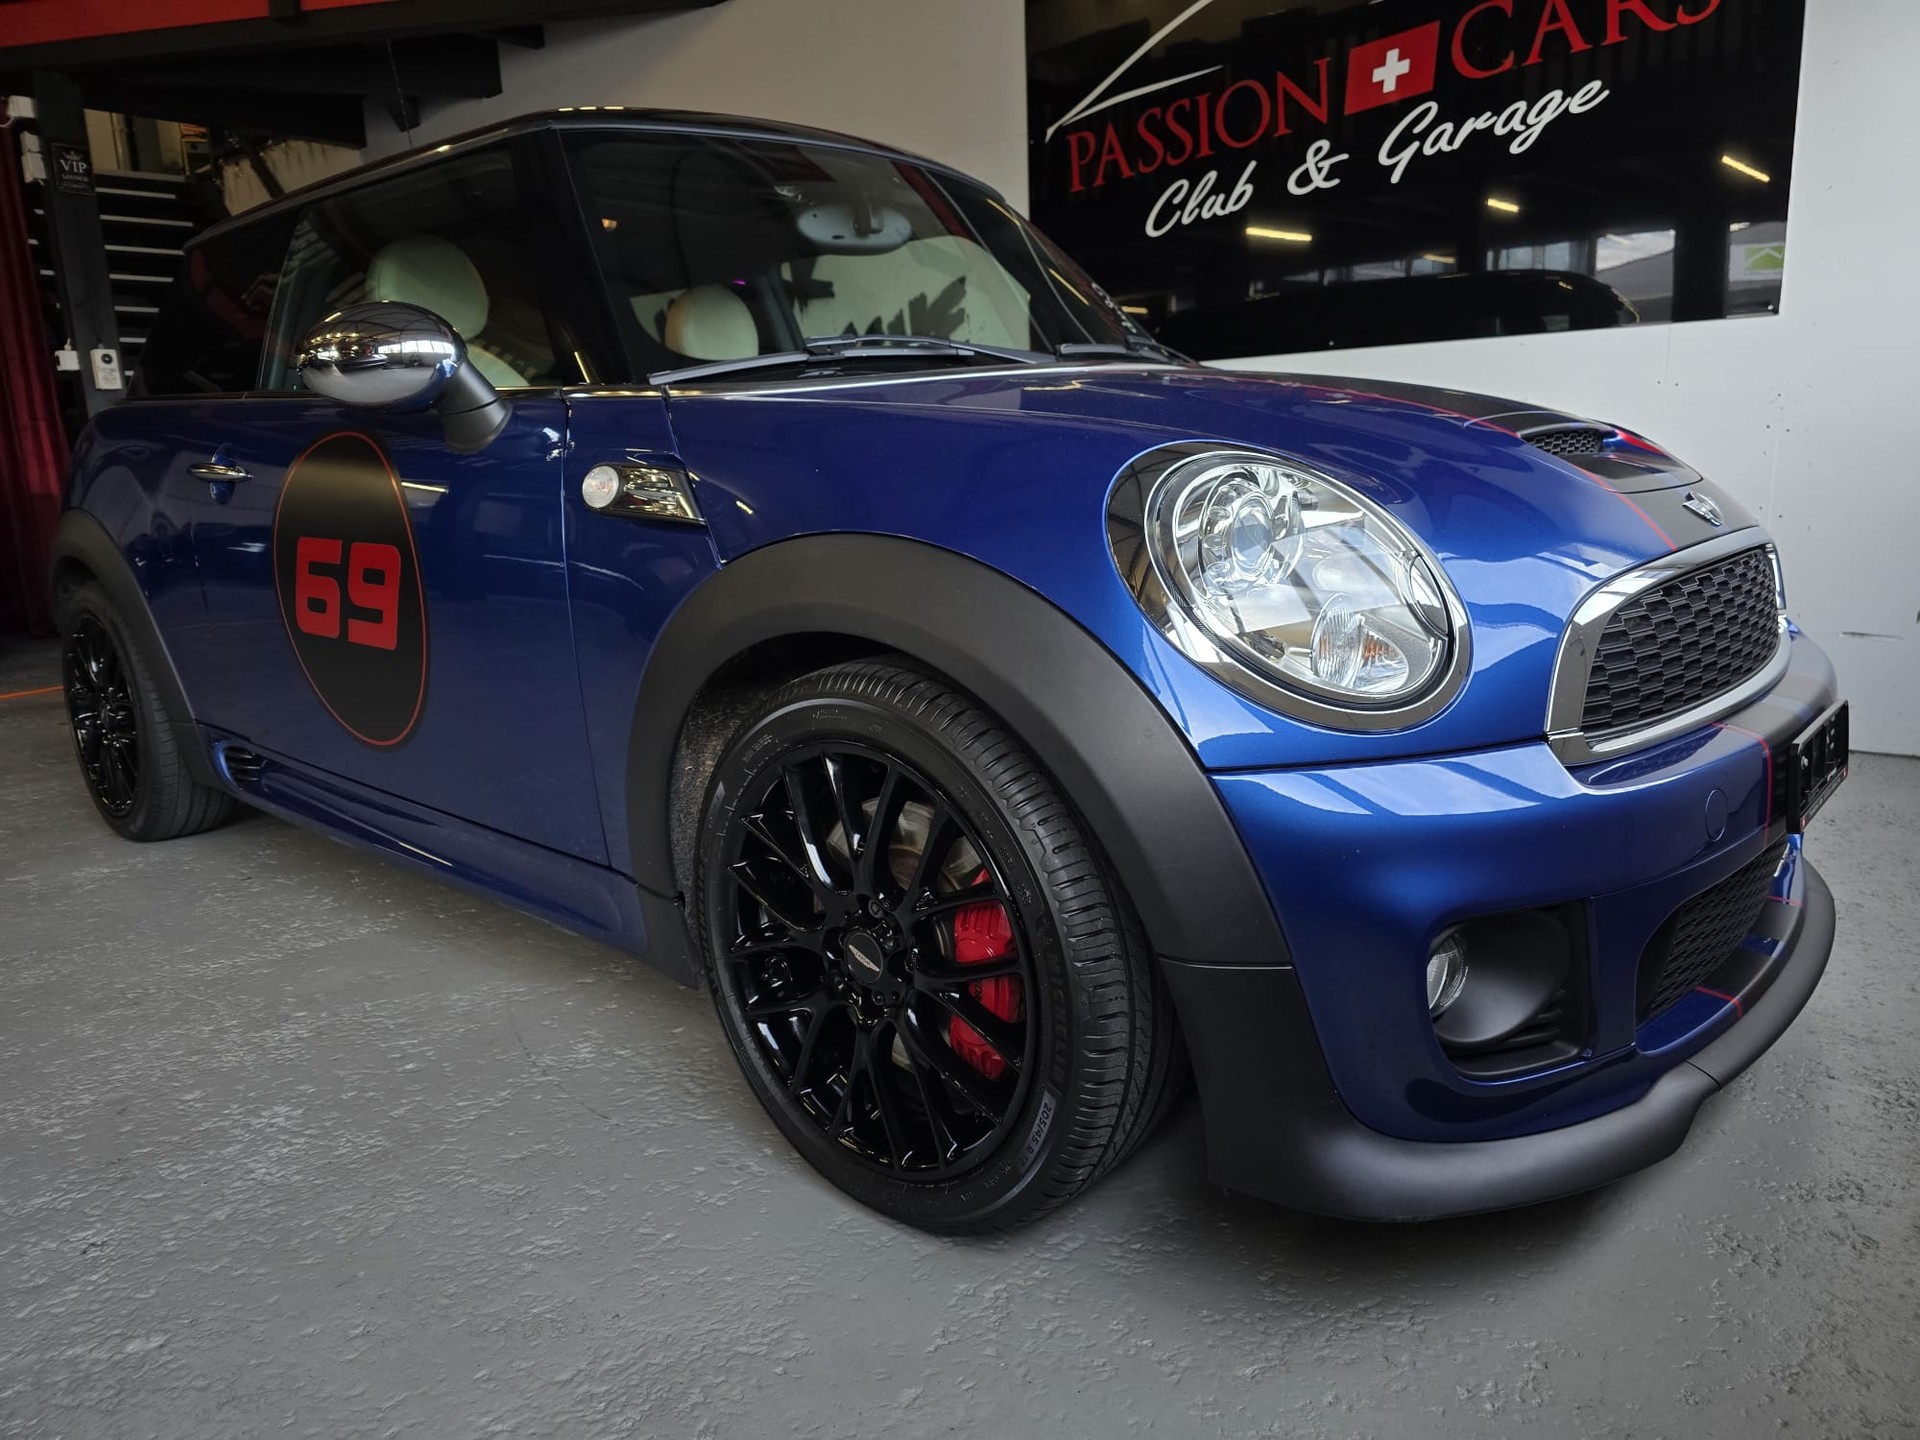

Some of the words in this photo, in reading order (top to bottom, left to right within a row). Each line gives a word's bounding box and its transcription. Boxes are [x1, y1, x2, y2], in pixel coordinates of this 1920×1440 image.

[1066, 57, 1331, 192] PASSION
[1145, 160, 1257, 237] Club
[1287, 139, 1349, 195] &
[1378, 80, 1610, 183] Garage
[60, 159, 87, 173] VIP
[295, 536, 401, 650] 69
[1025, 1145, 1034, 1154] R
[1031, 1102, 1052, 1145] 205/45
